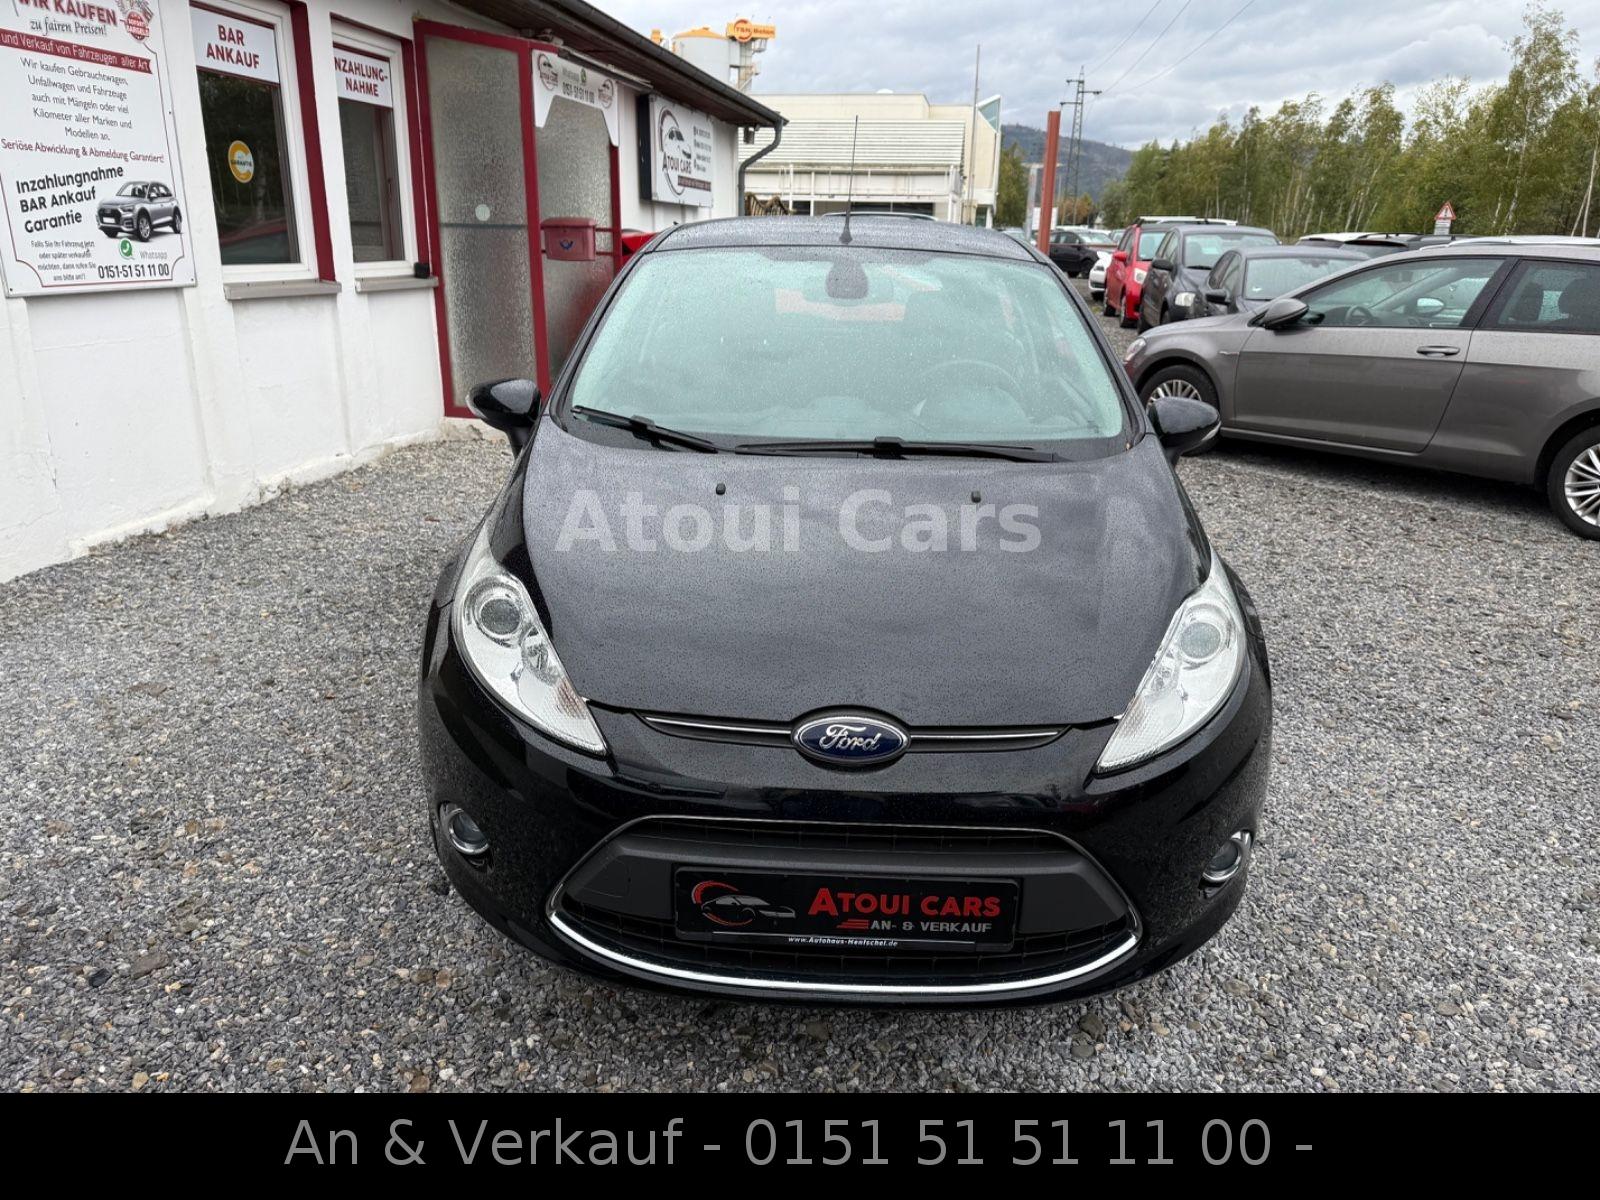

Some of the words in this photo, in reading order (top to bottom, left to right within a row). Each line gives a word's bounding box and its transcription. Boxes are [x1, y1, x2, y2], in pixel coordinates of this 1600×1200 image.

[53, 0, 117, 26] KAUFEN
[30, 20, 42, 30] zu
[42, 16, 72, 36] fairen
[74, 21, 107, 35] Preisen!
[217, 24, 245, 47] BAR
[1, 33, 19, 45] und
[20, 35, 54, 53] Verkauf
[55, 44, 71, 56] von
[72, 44, 118, 66] Fahrzeugen
[120, 56, 137, 68] aller
[138, 59, 149, 71] Art
[206, 42, 260, 70] ANKAUF
[20, 57, 38, 70] Wir
[39, 60, 66, 75] kaufen
[334, 57, 388, 83] NZAHLUNG-
[28, 74, 76, 93] Unfallwagen
[77, 82, 92, 95] und
[93, 86, 128, 101] Fahrzeuge
[345, 77, 379, 97] NAHME
[31, 93, 51, 104] auch
[53, 95, 66, 106] mit
[99, 101, 116, 112] oder
[117, 103, 129, 114] viel
[33, 107, 73, 122] Kilometer
[74, 112, 91, 124] aller
[92, 115, 119, 128] Marken
[120, 119, 133, 130] und
[64, 127, 99, 141] Modellen
[1, 138, 33, 152] Seriöse
[35, 142, 81, 159] Abwicklung
[81, 146, 89, 156] &
[89, 147, 129, 162] Abmeldung
[16, 166, 124, 194] Inzahlungnahme
[20, 198, 47, 213] BAR
[50, 187, 97, 211] Ankauf
[24, 210, 83, 233] Garantie
[97, 263, 133, 279] 0151-51
[134, 263, 146, 277] 51
[147, 263, 157, 277] 11
[158, 262, 170, 276] 00
[818, 723, 883, 750] Ford
[920, 895, 1001, 918] CARS
[870, 920, 897, 930] AN-
[902, 920, 915, 931] &
[920, 921, 993, 933] VERKAUF
